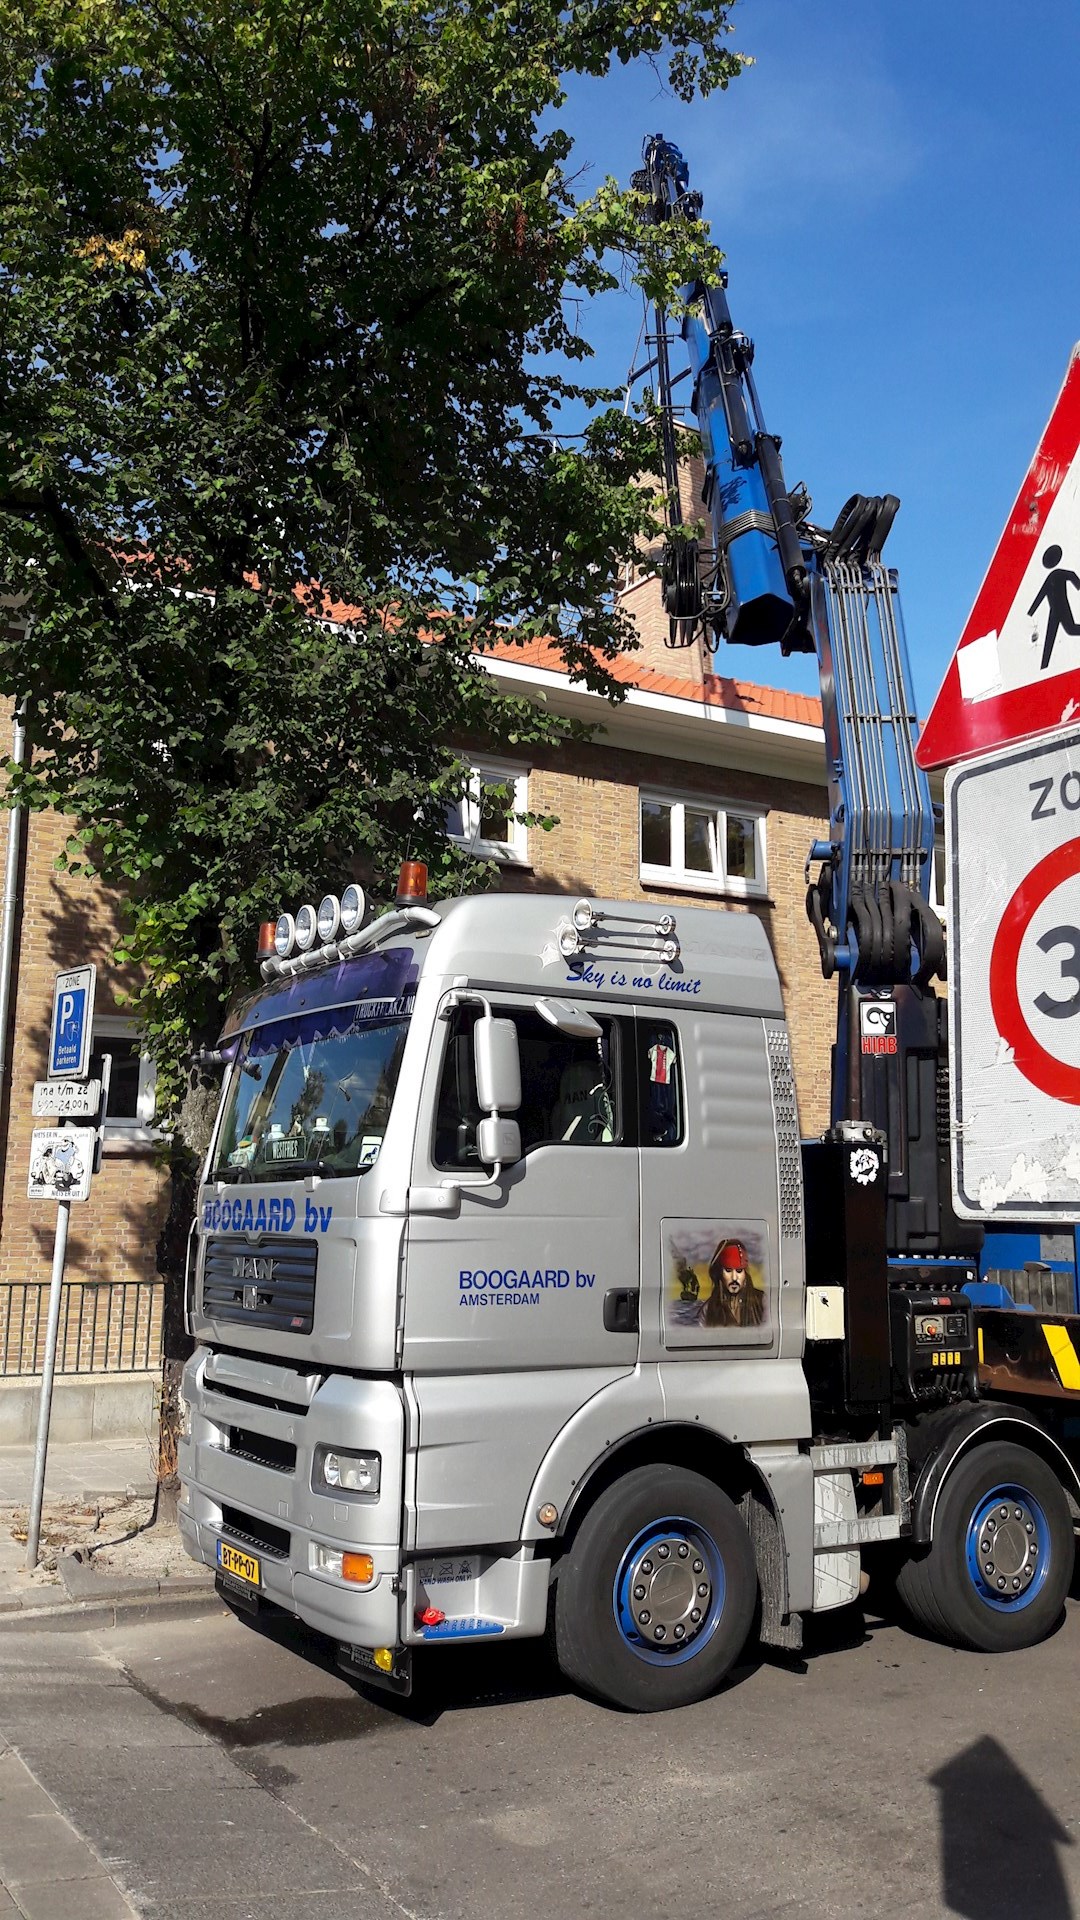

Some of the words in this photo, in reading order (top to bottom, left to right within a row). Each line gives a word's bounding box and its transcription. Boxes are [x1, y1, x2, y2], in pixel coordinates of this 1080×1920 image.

[65, 976, 80, 988] ZONE
[566, 962, 605, 989] Sky
[610, 971, 627, 987] is
[632, 976, 654, 989] no
[658, 972, 702, 994] limit
[60, 995, 74, 1034] P
[58, 1044, 76, 1054] Betaald
[861, 1036, 898, 1055] HIAB
[56, 1056, 76, 1066] parkeren
[40, 1087, 54, 1096] ma
[57, 1083, 74, 1096] t/m
[203, 1198, 296, 1232] BOOGAARD
[304, 1197, 333, 1233] bv
[232, 1257, 273, 1280] MAN
[459, 1269, 570, 1290] BOOGAARD
[575, 1270, 596, 1289] bv
[459, 1292, 540, 1306] AMSTERDAM
[223, 1547, 255, 1579] BT-PP-07
